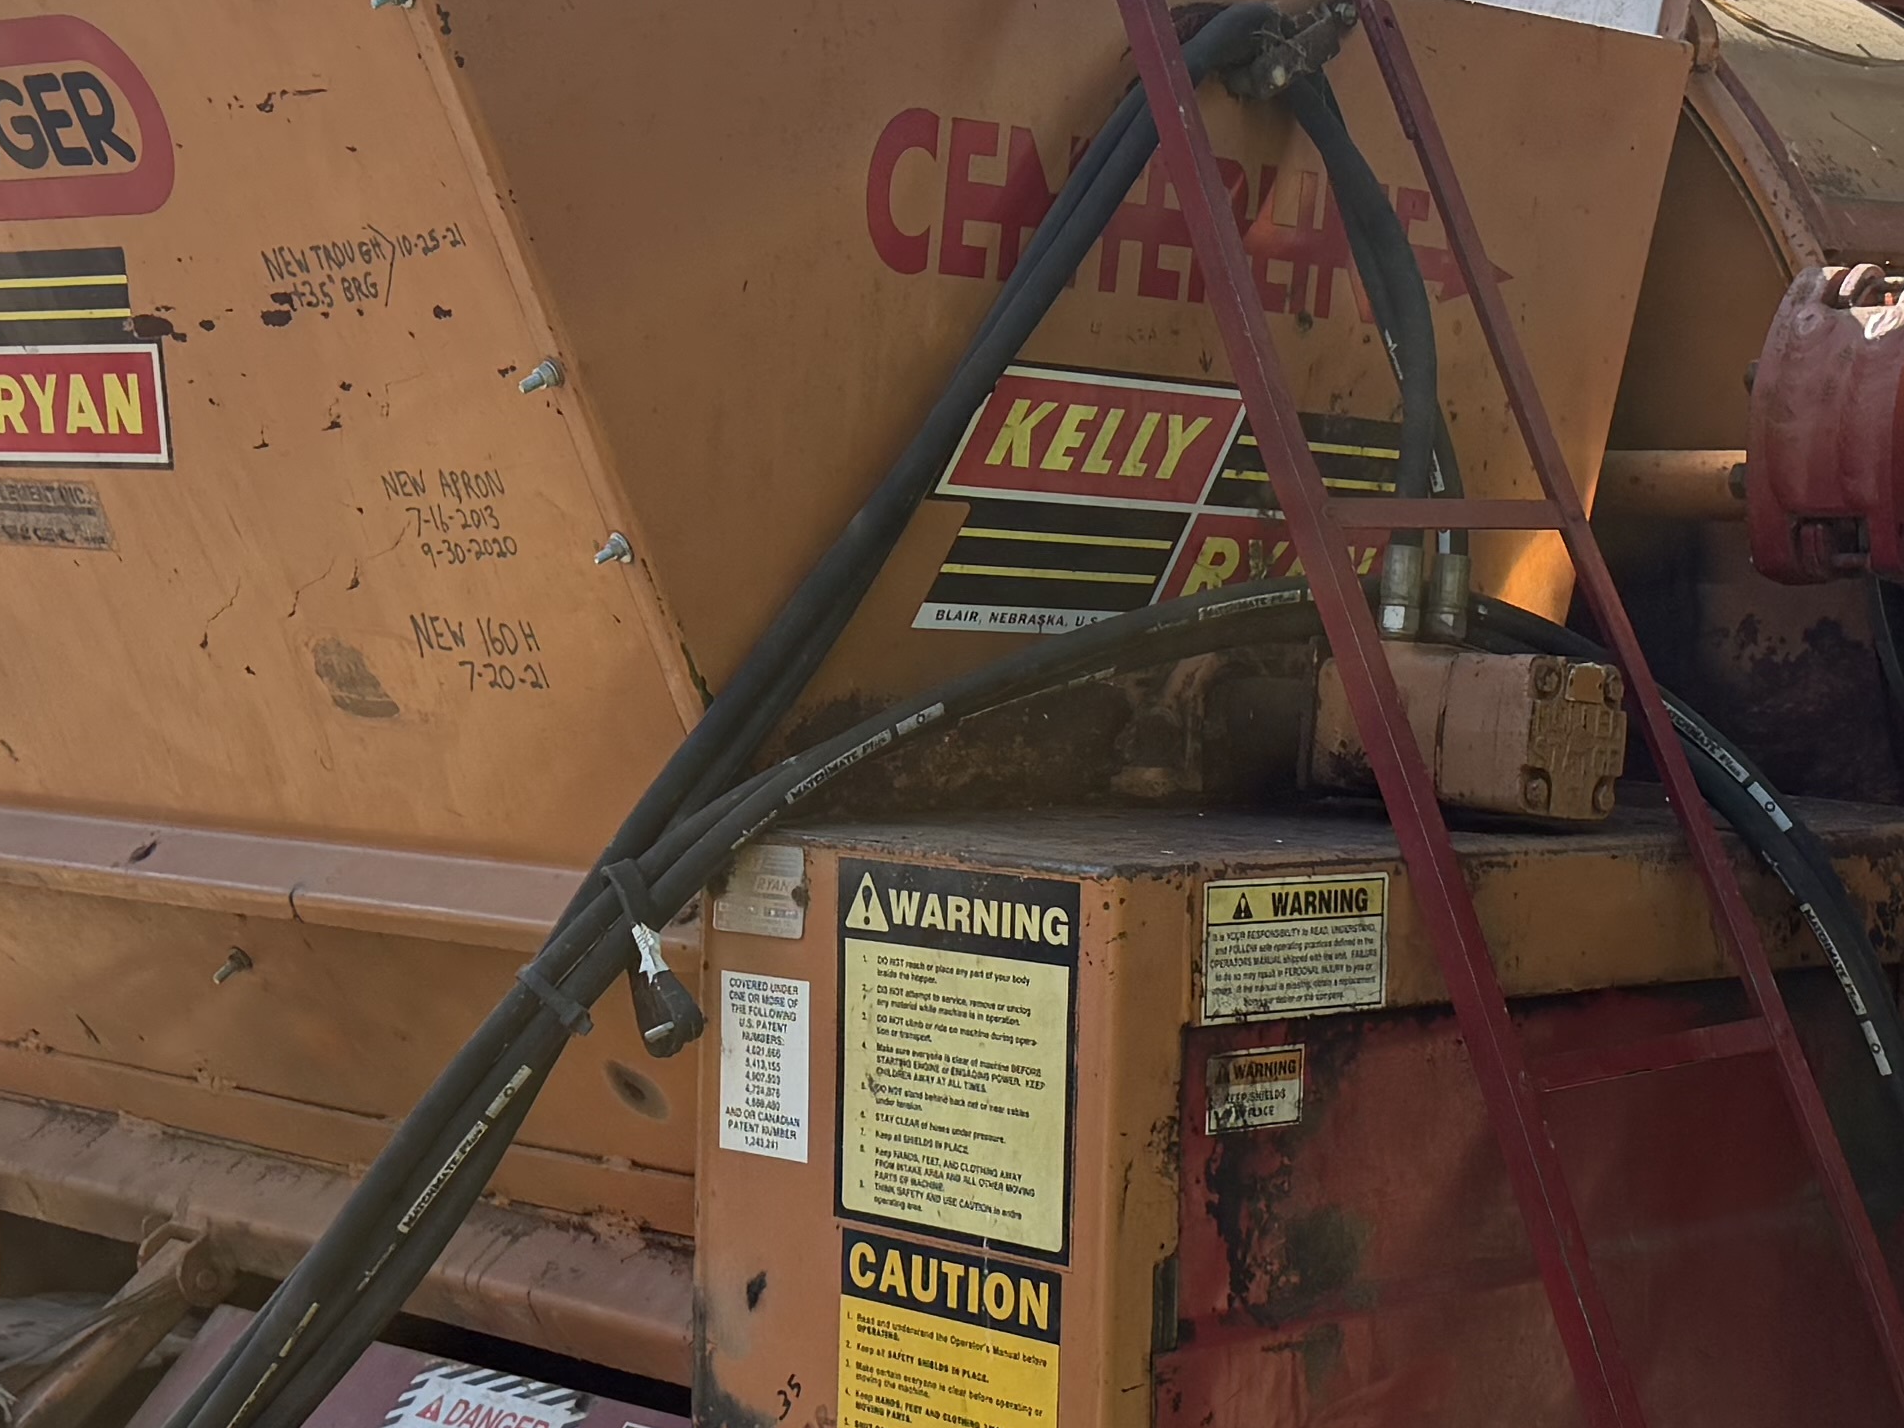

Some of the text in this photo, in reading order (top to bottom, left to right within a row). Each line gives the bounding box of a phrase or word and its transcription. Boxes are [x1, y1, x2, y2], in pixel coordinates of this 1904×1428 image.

[261, 246, 310, 282] NEW
[309, 235, 386, 271] TROUGH
[341, 272, 378, 302] BRG
[984, 399, 1212, 479] KELLY
[381, 469, 504, 504] NEW APRON
[406, 504, 499, 537] 7-16-2013
[421, 536, 517, 568] 9-30-2020
[1181, 536, 1376, 595] RY
[936, 609, 983, 624] BLAIR,
[989, 612, 1069, 627] NEBRASKA,
[409, 613, 465, 658] NEW
[459, 661, 550, 691] 7-20-21
[888, 888, 1069, 946] WARNING
[1272, 888, 1368, 917] WARNING
[729, 978, 768, 992] COVERED
[756, 1020, 787, 1033] PATENT
[1233, 1060, 1296, 1079] WARNING
[728, 1119, 759, 1133] PATENT
[895, 1115, 919, 1128] CLEAR
[849, 1242, 1049, 1330] CAUTION
[777, 1374, 801, 1420] 35
